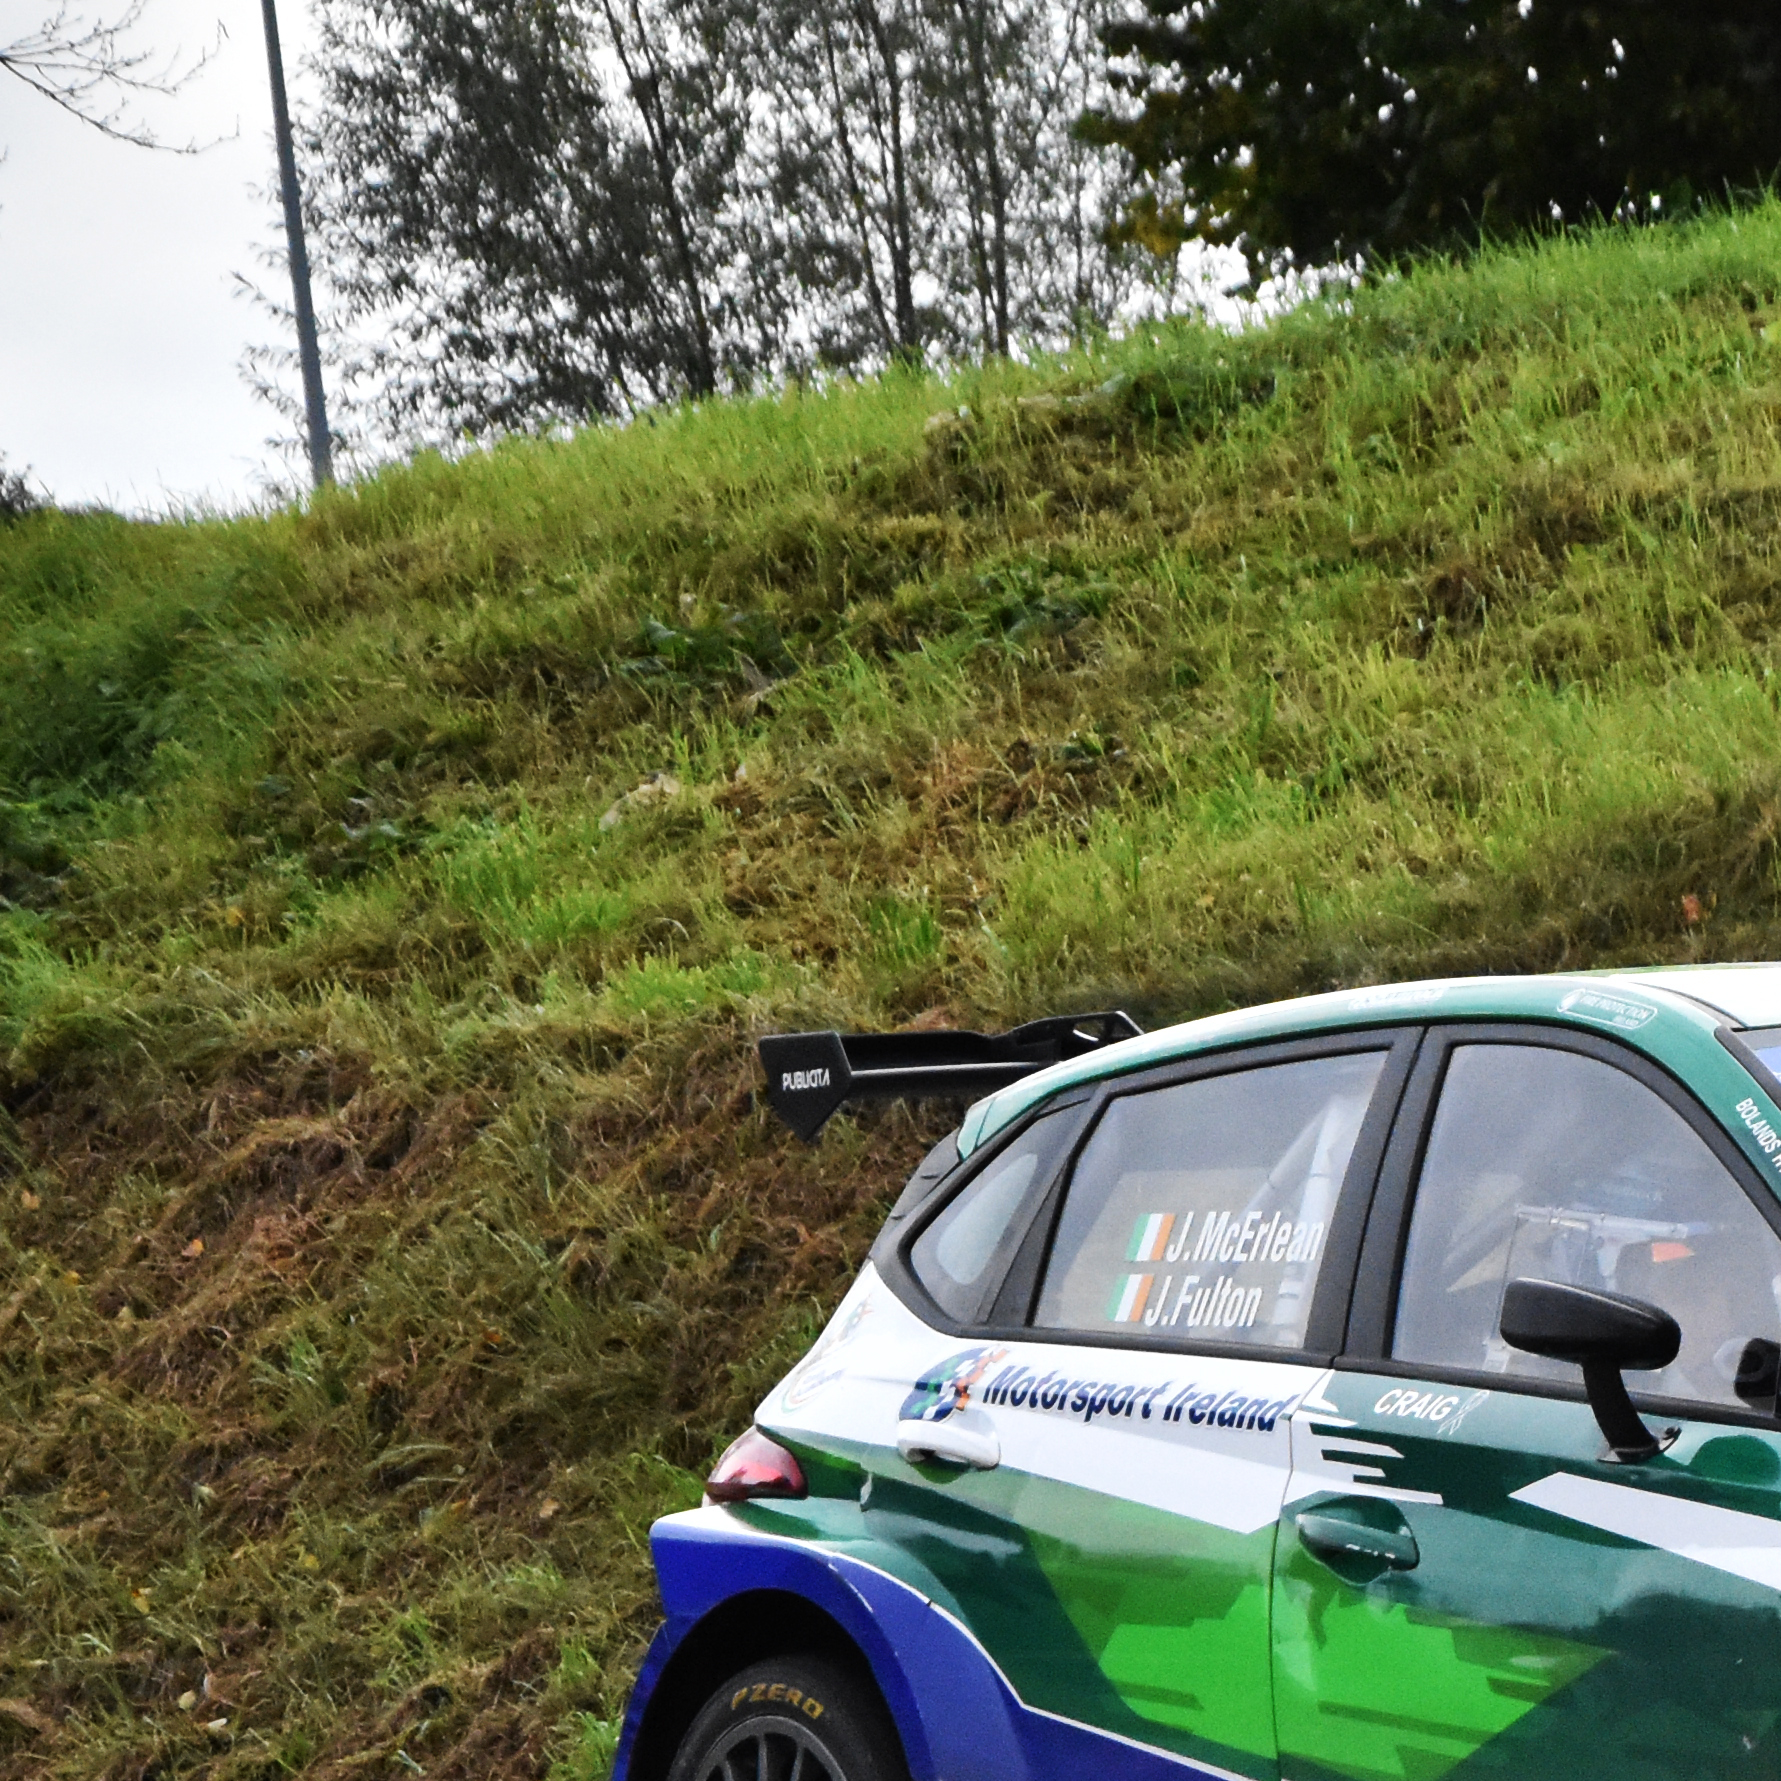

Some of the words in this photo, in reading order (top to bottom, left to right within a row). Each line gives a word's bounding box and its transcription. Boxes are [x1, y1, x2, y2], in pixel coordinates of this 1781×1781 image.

[1166, 1210, 1325, 1263] J.McErlean
[1144, 1275, 1263, 1327] J.Fulton
[982, 1364, 1174, 1423] Motorsport
[1163, 1381, 1300, 1432] Ireland
[1373, 1388, 1459, 1421] CRAIG
